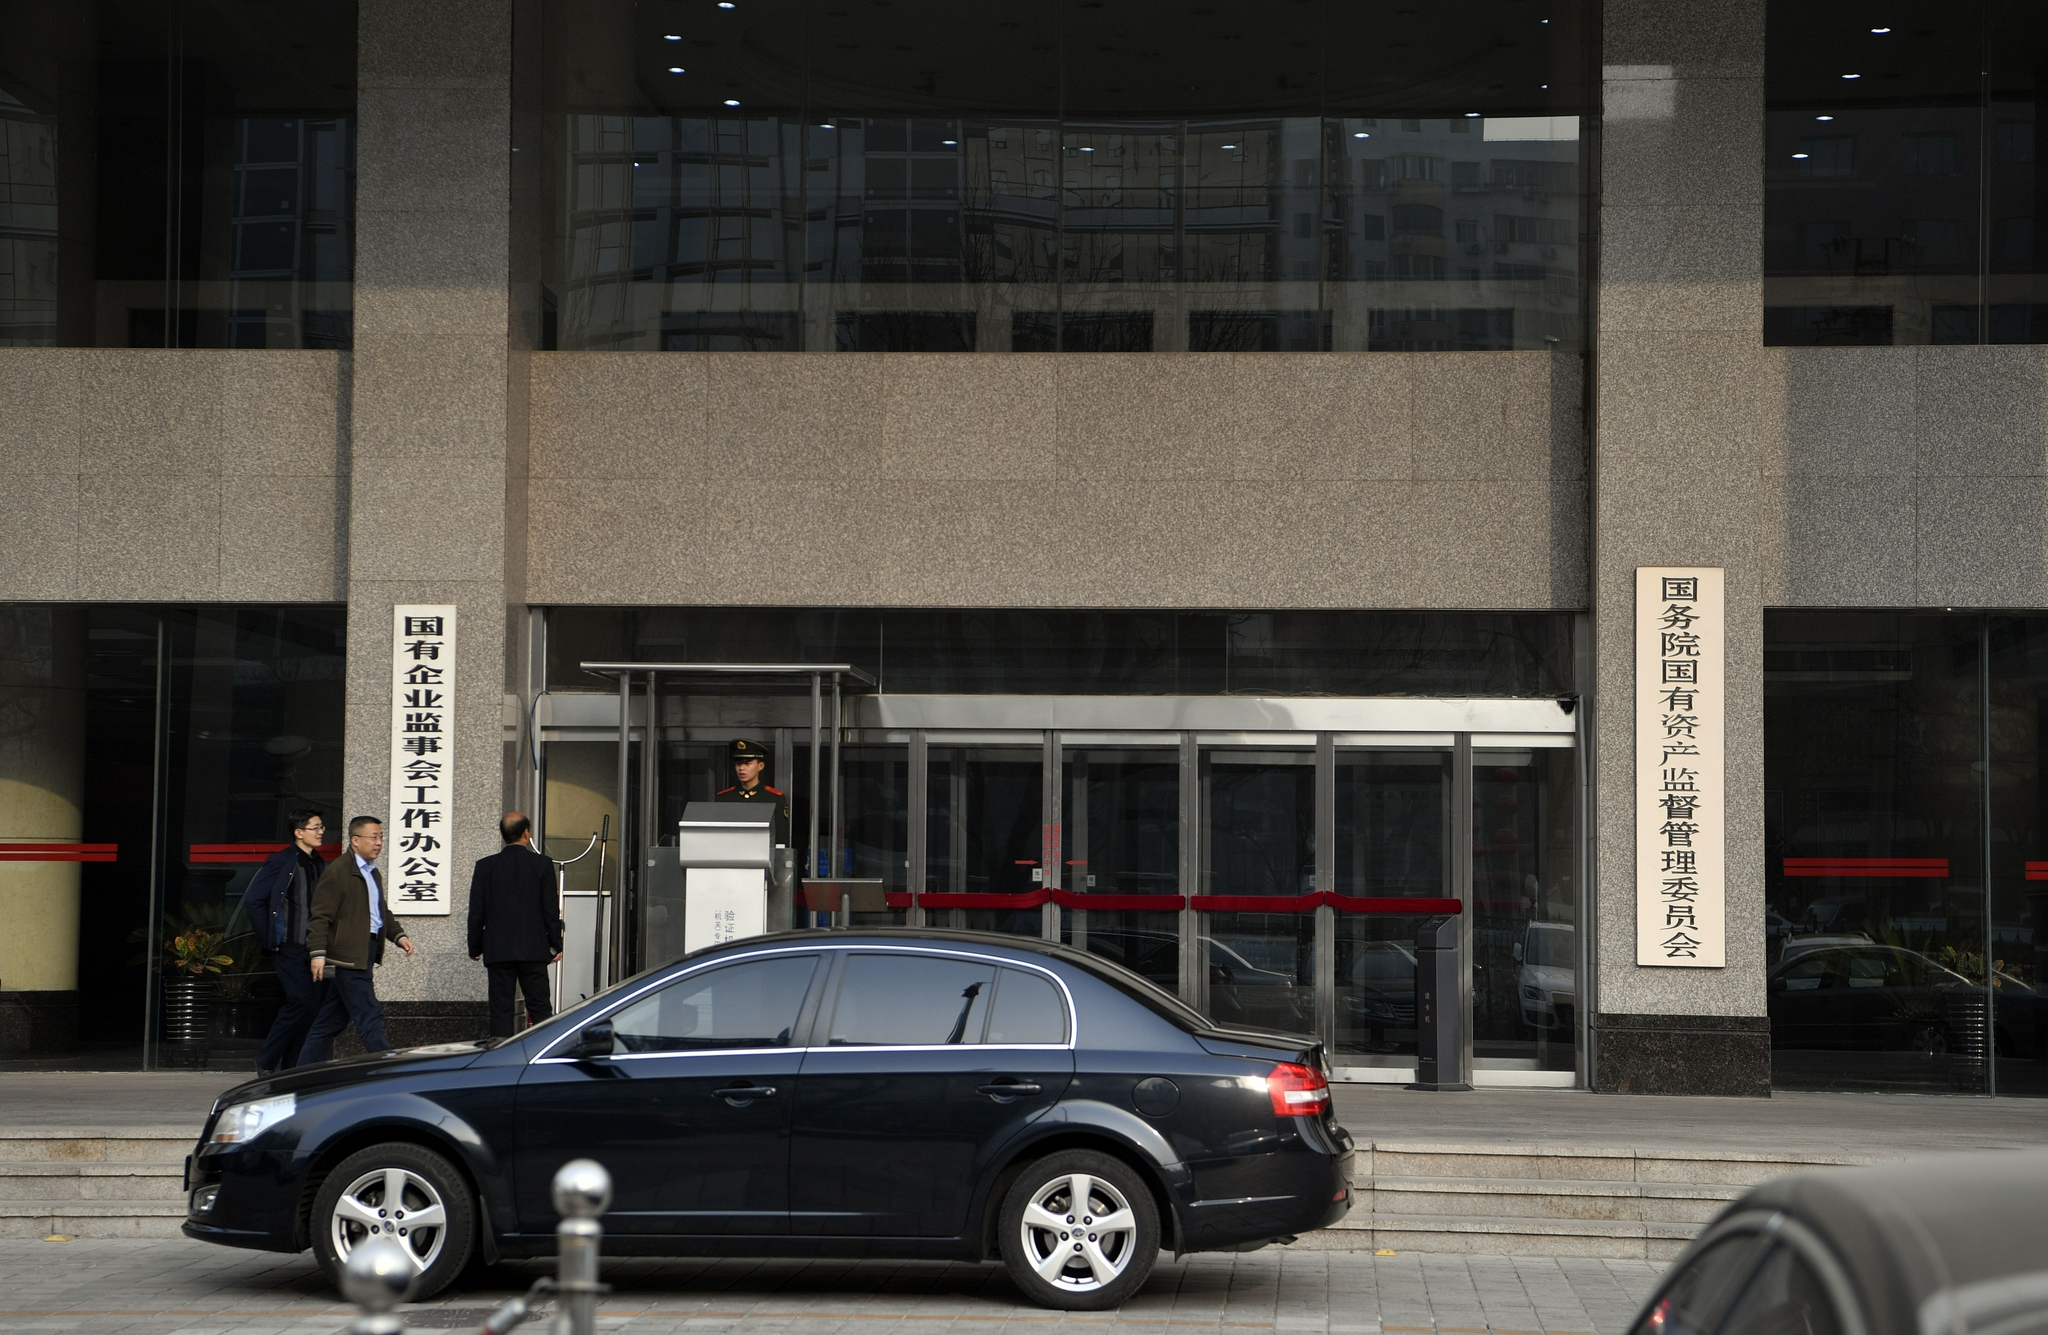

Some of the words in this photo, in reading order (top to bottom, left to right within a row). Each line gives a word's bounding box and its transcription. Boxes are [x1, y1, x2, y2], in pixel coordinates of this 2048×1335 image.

[398, 616, 444, 902] 国有企业监事会工作办公室
[1658, 577, 1702, 958] 国务院国有资产监督管理委员会
